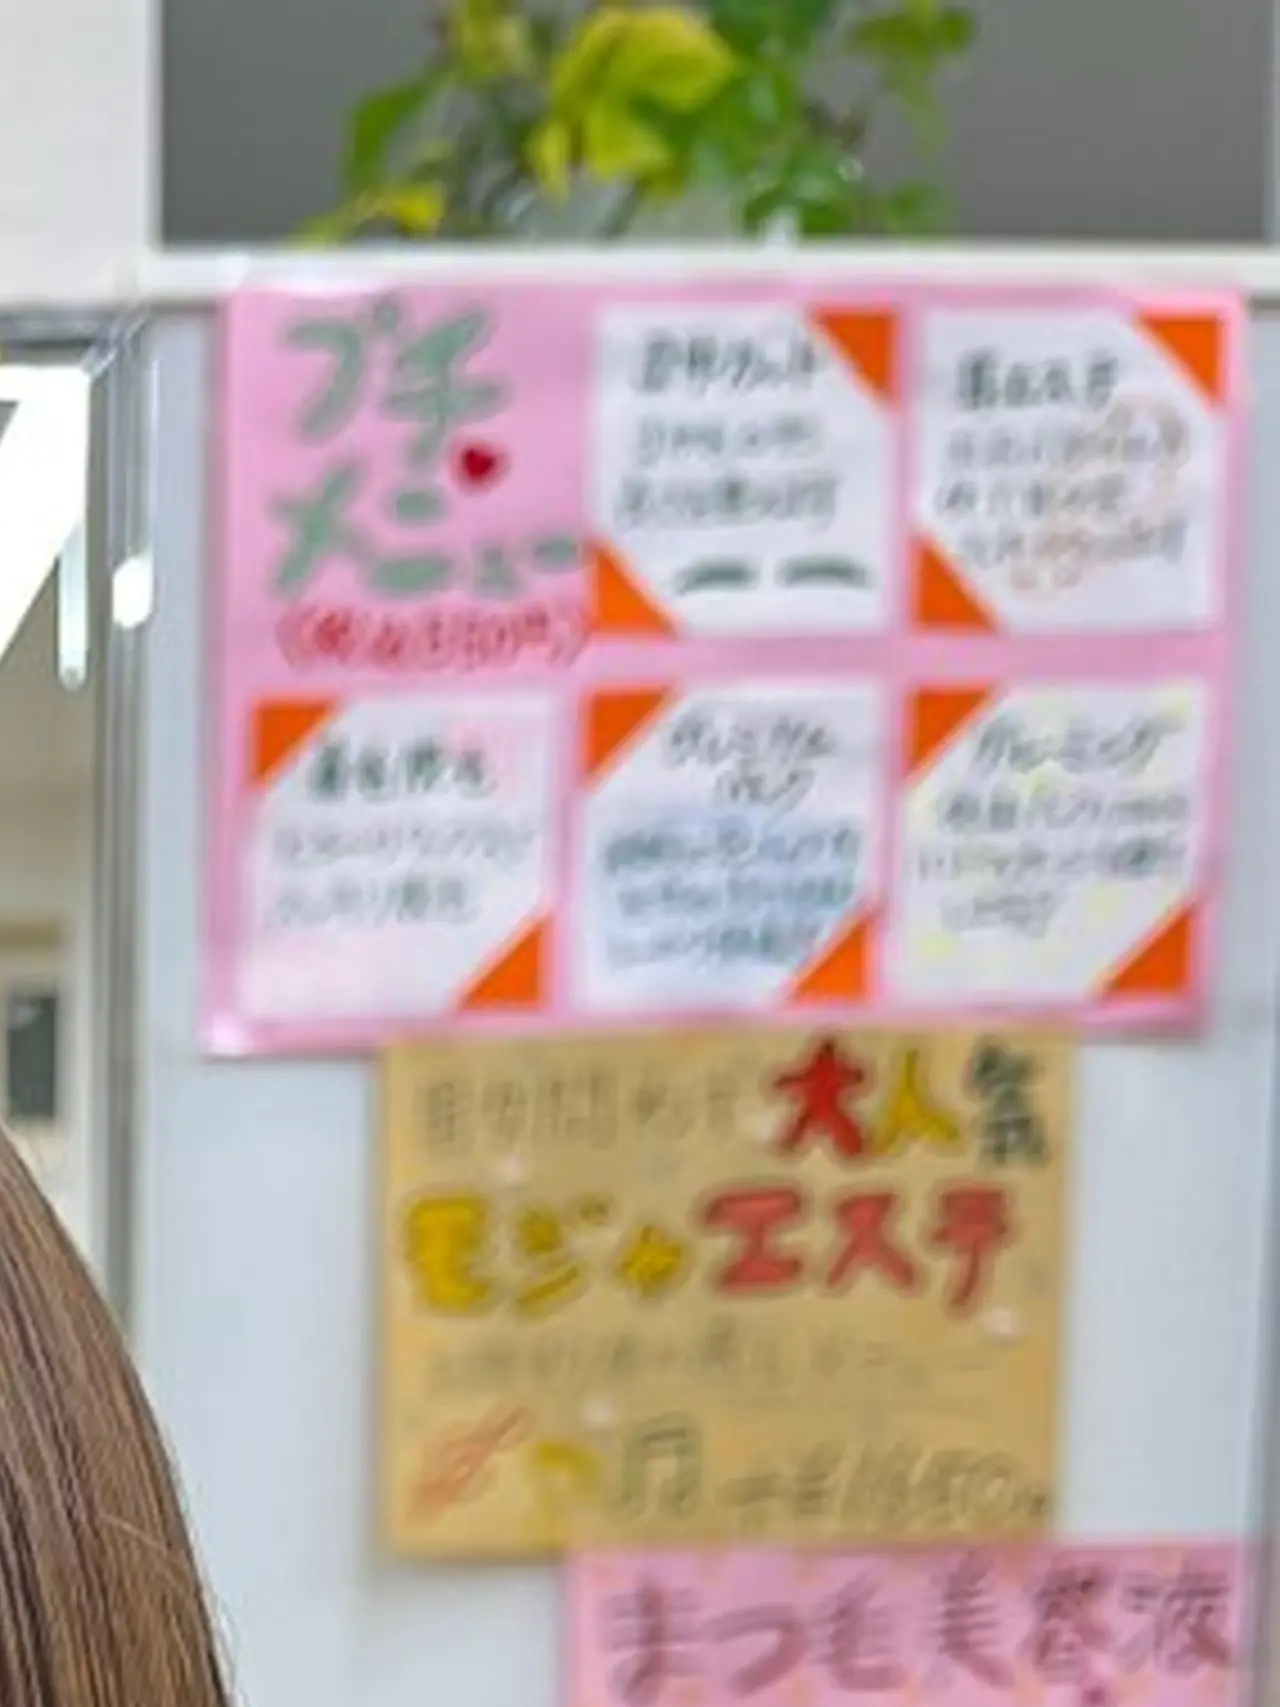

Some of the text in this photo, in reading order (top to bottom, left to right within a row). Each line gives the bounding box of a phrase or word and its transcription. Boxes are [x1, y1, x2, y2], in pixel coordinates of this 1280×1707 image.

[282, 298, 509, 466] プチ
[266, 462, 586, 596] メニュー
